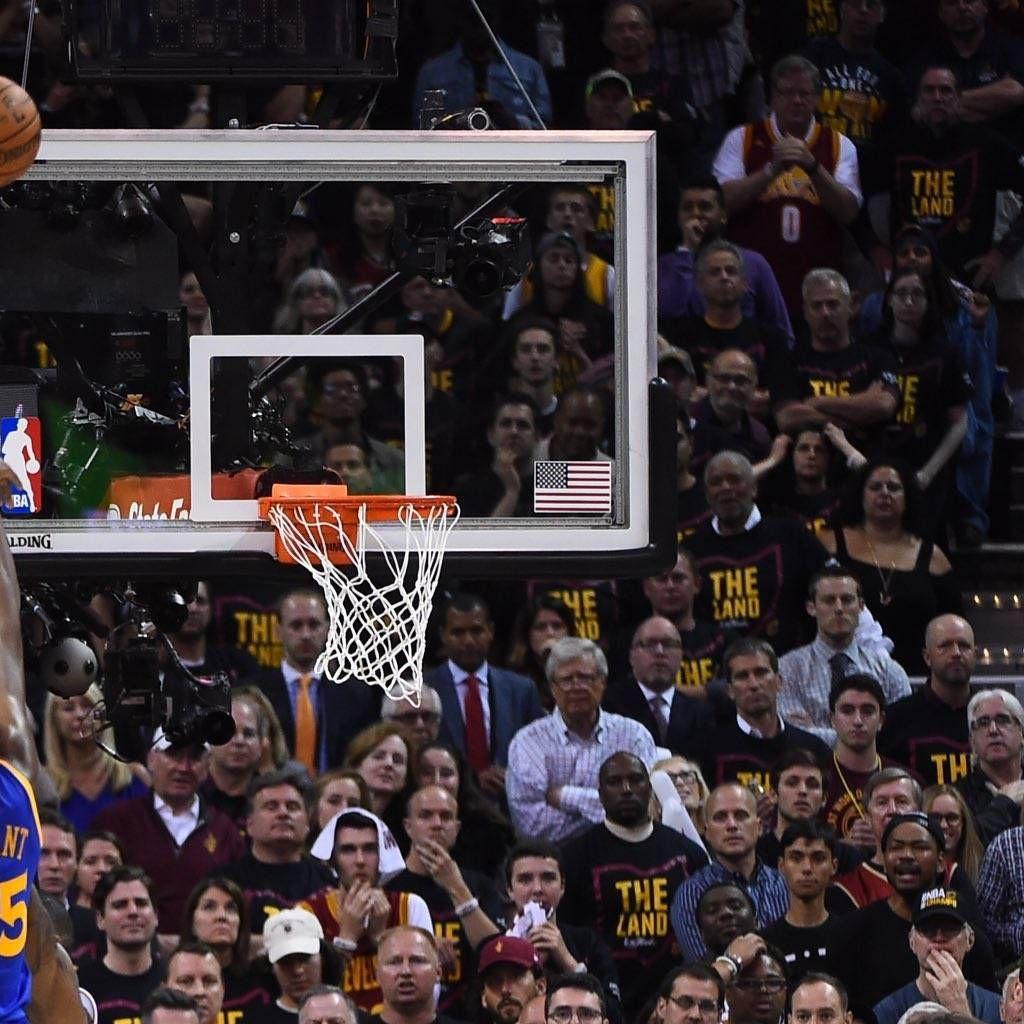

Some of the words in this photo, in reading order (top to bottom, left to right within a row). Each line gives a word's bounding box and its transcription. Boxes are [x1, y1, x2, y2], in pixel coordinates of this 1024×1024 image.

[912, 168, 957, 197] THE
[911, 197, 956, 217] LAND
[781, 203, 801, 243] 0
[12, 494, 29, 508] BA
[6, 534, 53, 550] ALDING
[709, 565, 760, 600] THE
[713, 600, 761, 621] LAND
[930, 753, 976, 786] TH
[615, 877, 669, 913] THE
[616, 911, 669, 938] LAND
